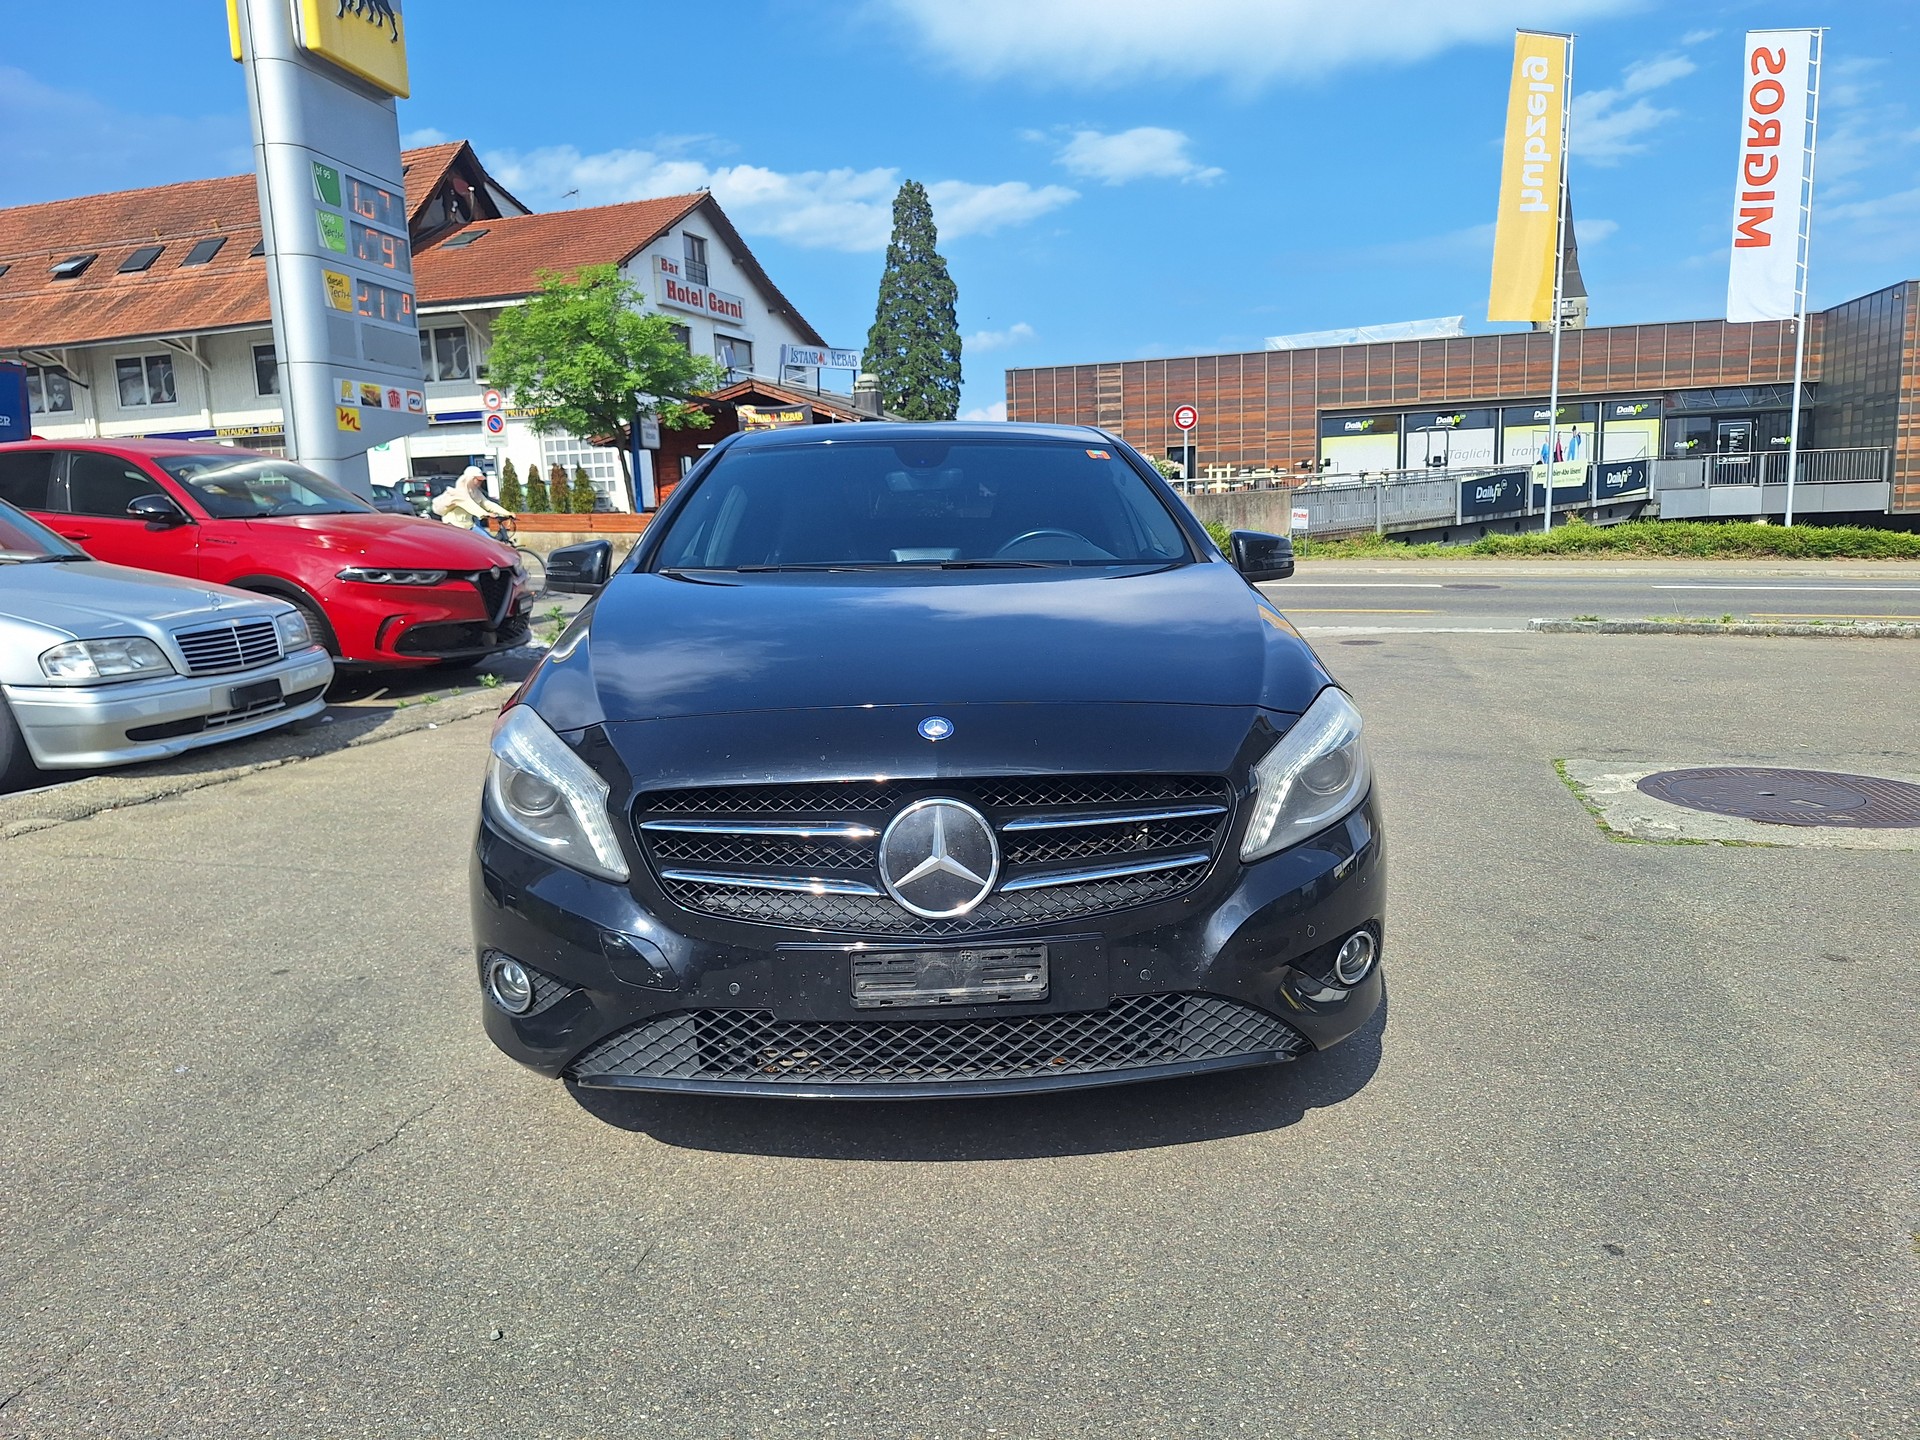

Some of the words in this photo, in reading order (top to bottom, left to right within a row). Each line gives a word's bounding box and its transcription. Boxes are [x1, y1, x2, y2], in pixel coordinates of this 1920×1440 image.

[660, 257, 679, 275] Bar
[666, 279, 704, 309] Hotel
[708, 292, 743, 319] Garni
[790, 347, 827, 366] ISTANBL
[830, 350, 858, 367] KEBAB
[1448, 448, 1491, 461] Täglich
